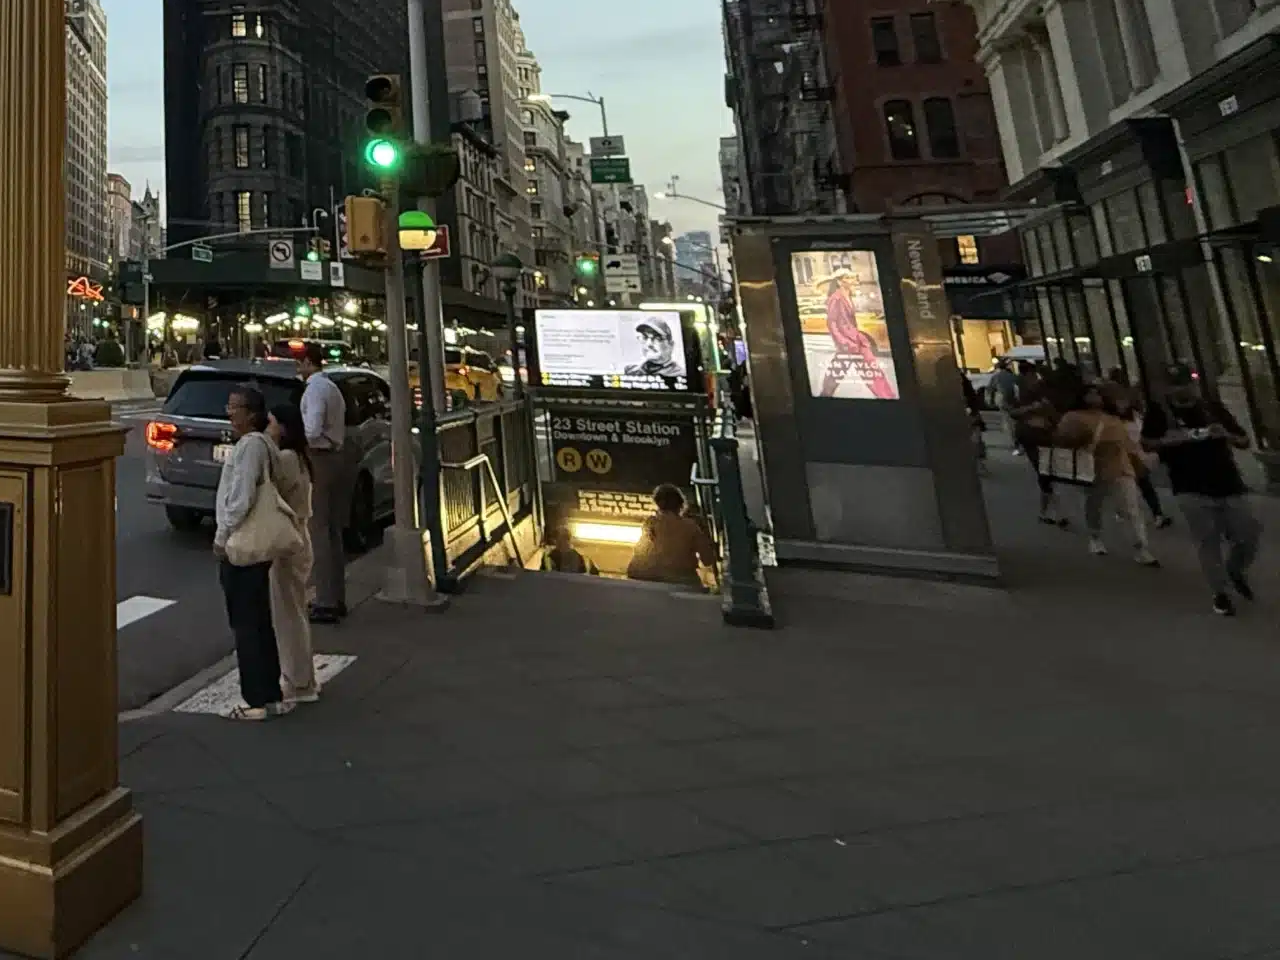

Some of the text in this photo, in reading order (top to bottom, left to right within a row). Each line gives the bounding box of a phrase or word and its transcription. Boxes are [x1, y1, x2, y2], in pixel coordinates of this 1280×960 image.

[907, 241, 937, 320] Newsstand
[944, 276, 988, 285] MERICA
[553, 418, 680, 436] 23 Street Station
[554, 430, 671, 447] Downtown & Brooklyn
[563, 452, 607, 469] R W
